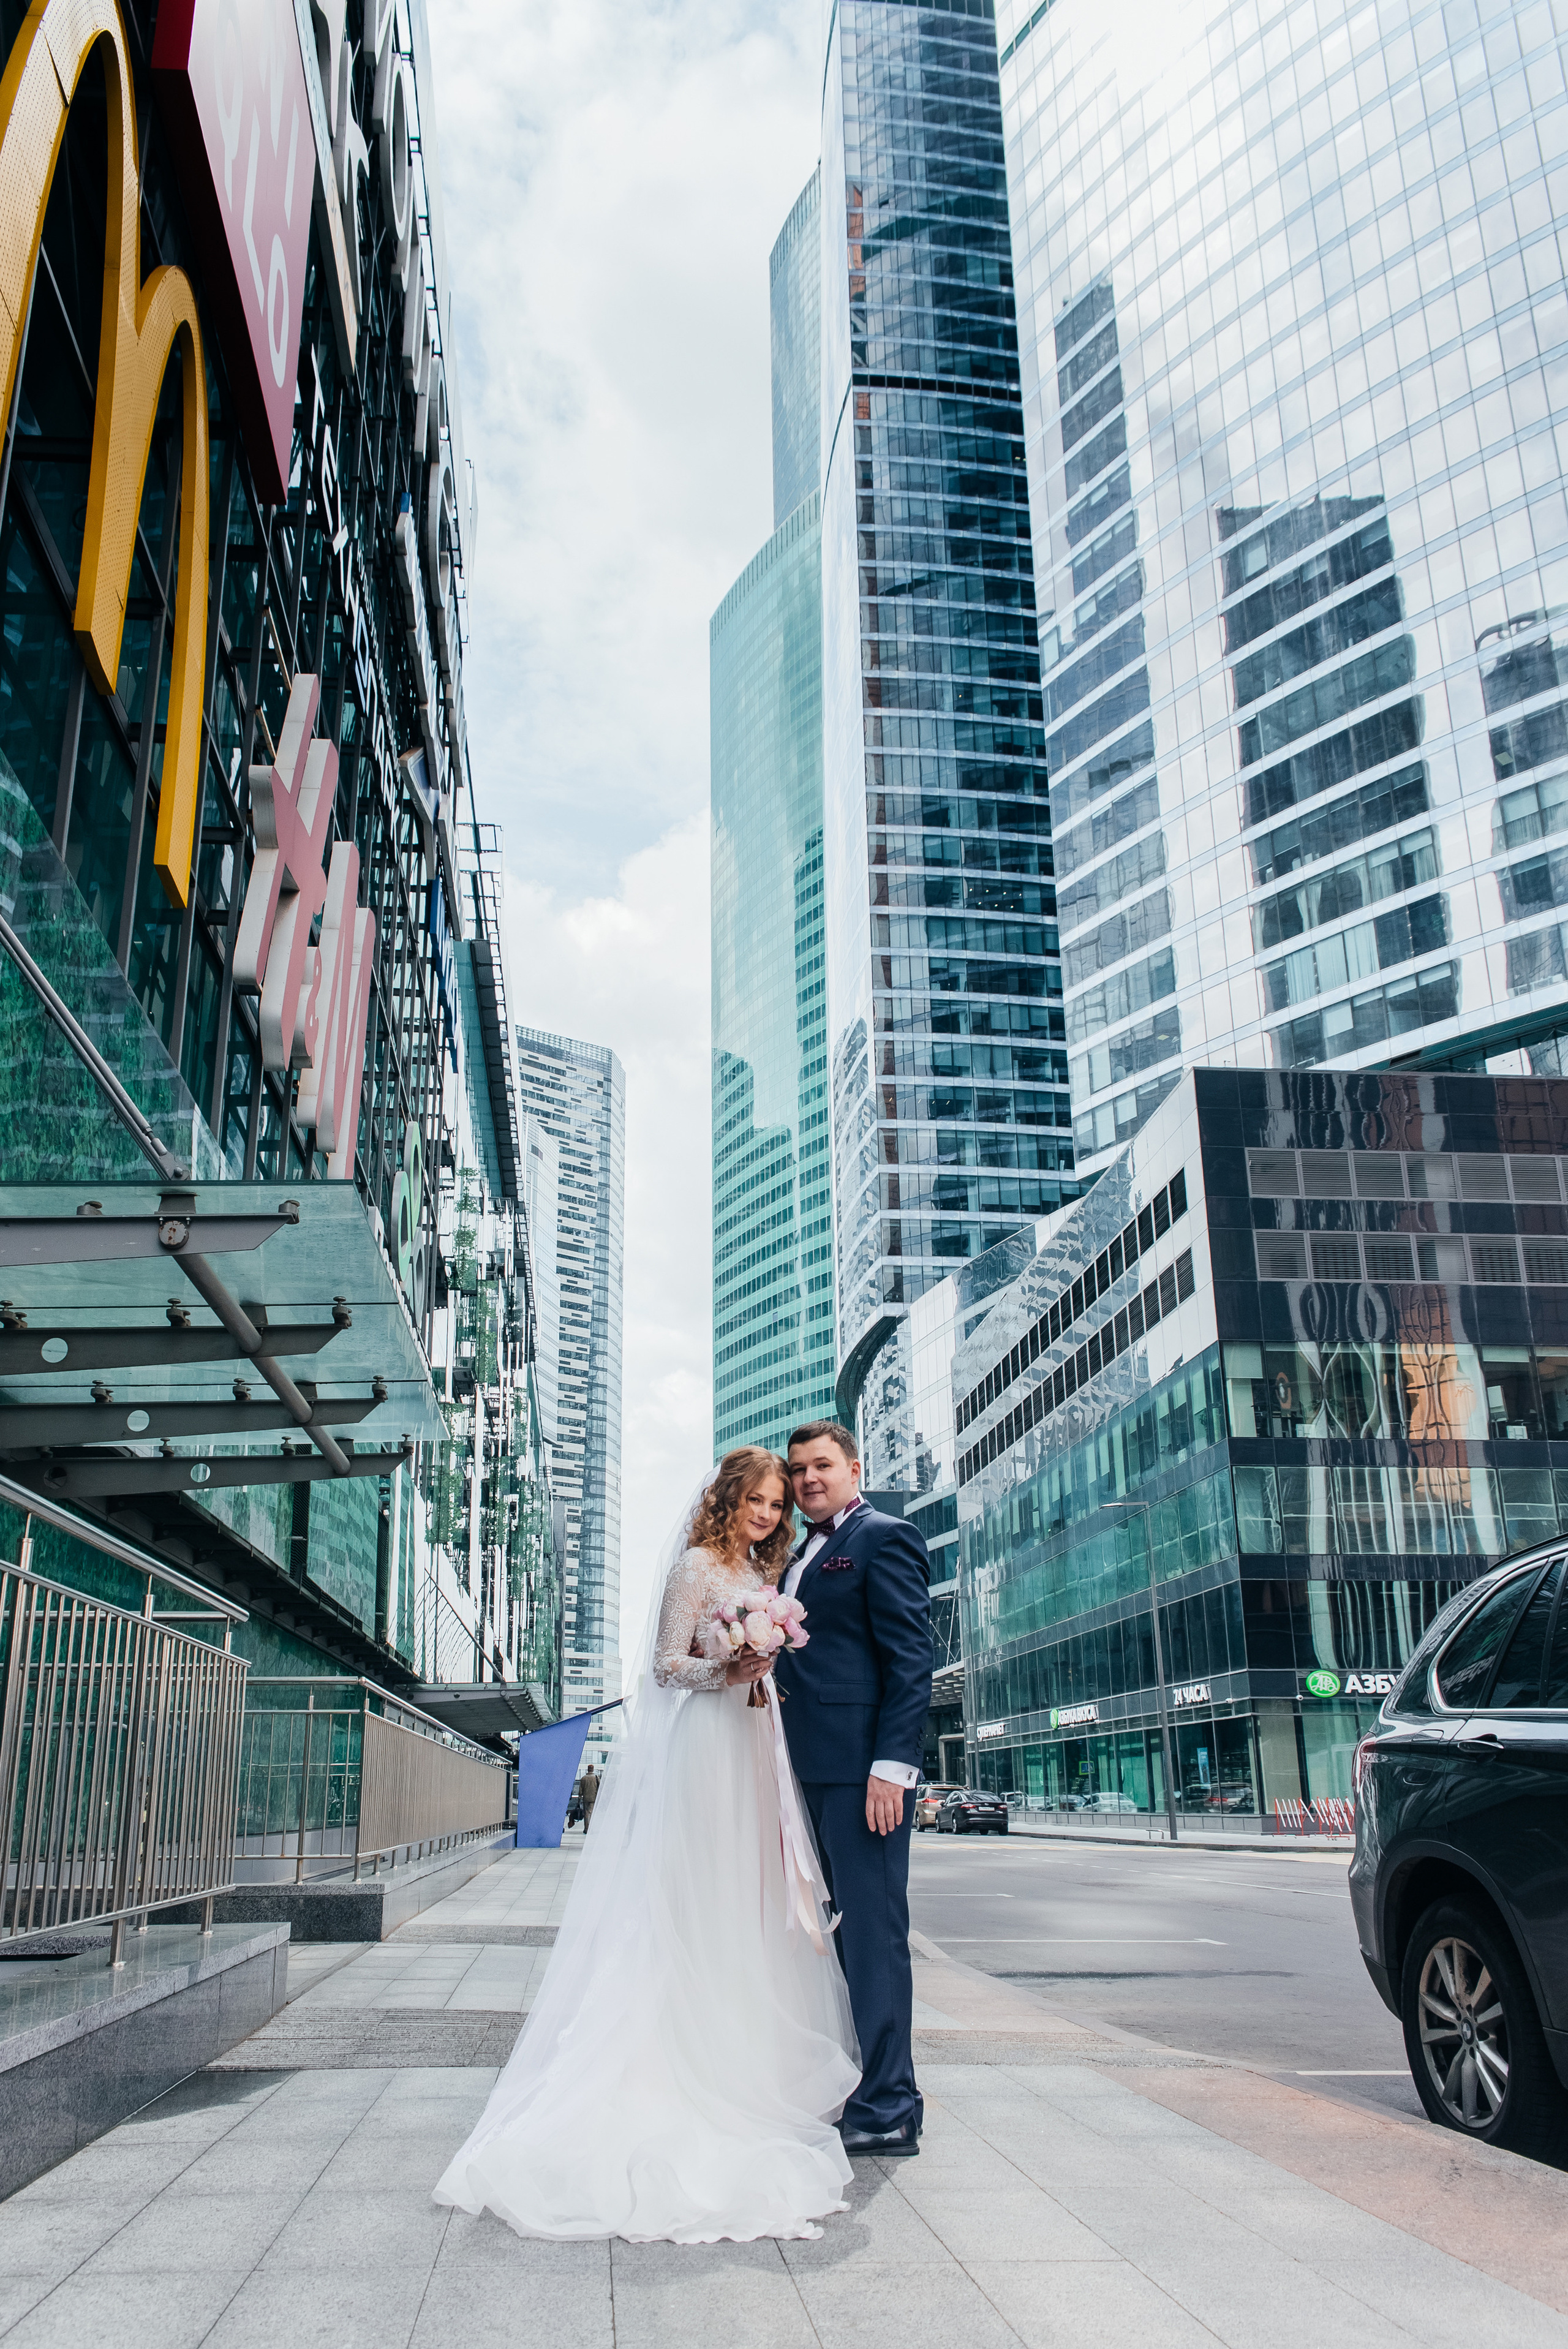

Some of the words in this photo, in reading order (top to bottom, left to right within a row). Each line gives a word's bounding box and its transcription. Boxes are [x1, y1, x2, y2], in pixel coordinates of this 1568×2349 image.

[311, 343, 400, 862] ТЕХНОПАРК
[233, 674, 375, 1180] H&M
[1058, 1708, 1077, 1725] АЗБУКА
[1077, 1705, 1096, 1722] ВКУСА
[1173, 1689, 1183, 1705] 24
[1182, 1684, 1208, 1703] ЧАСА
